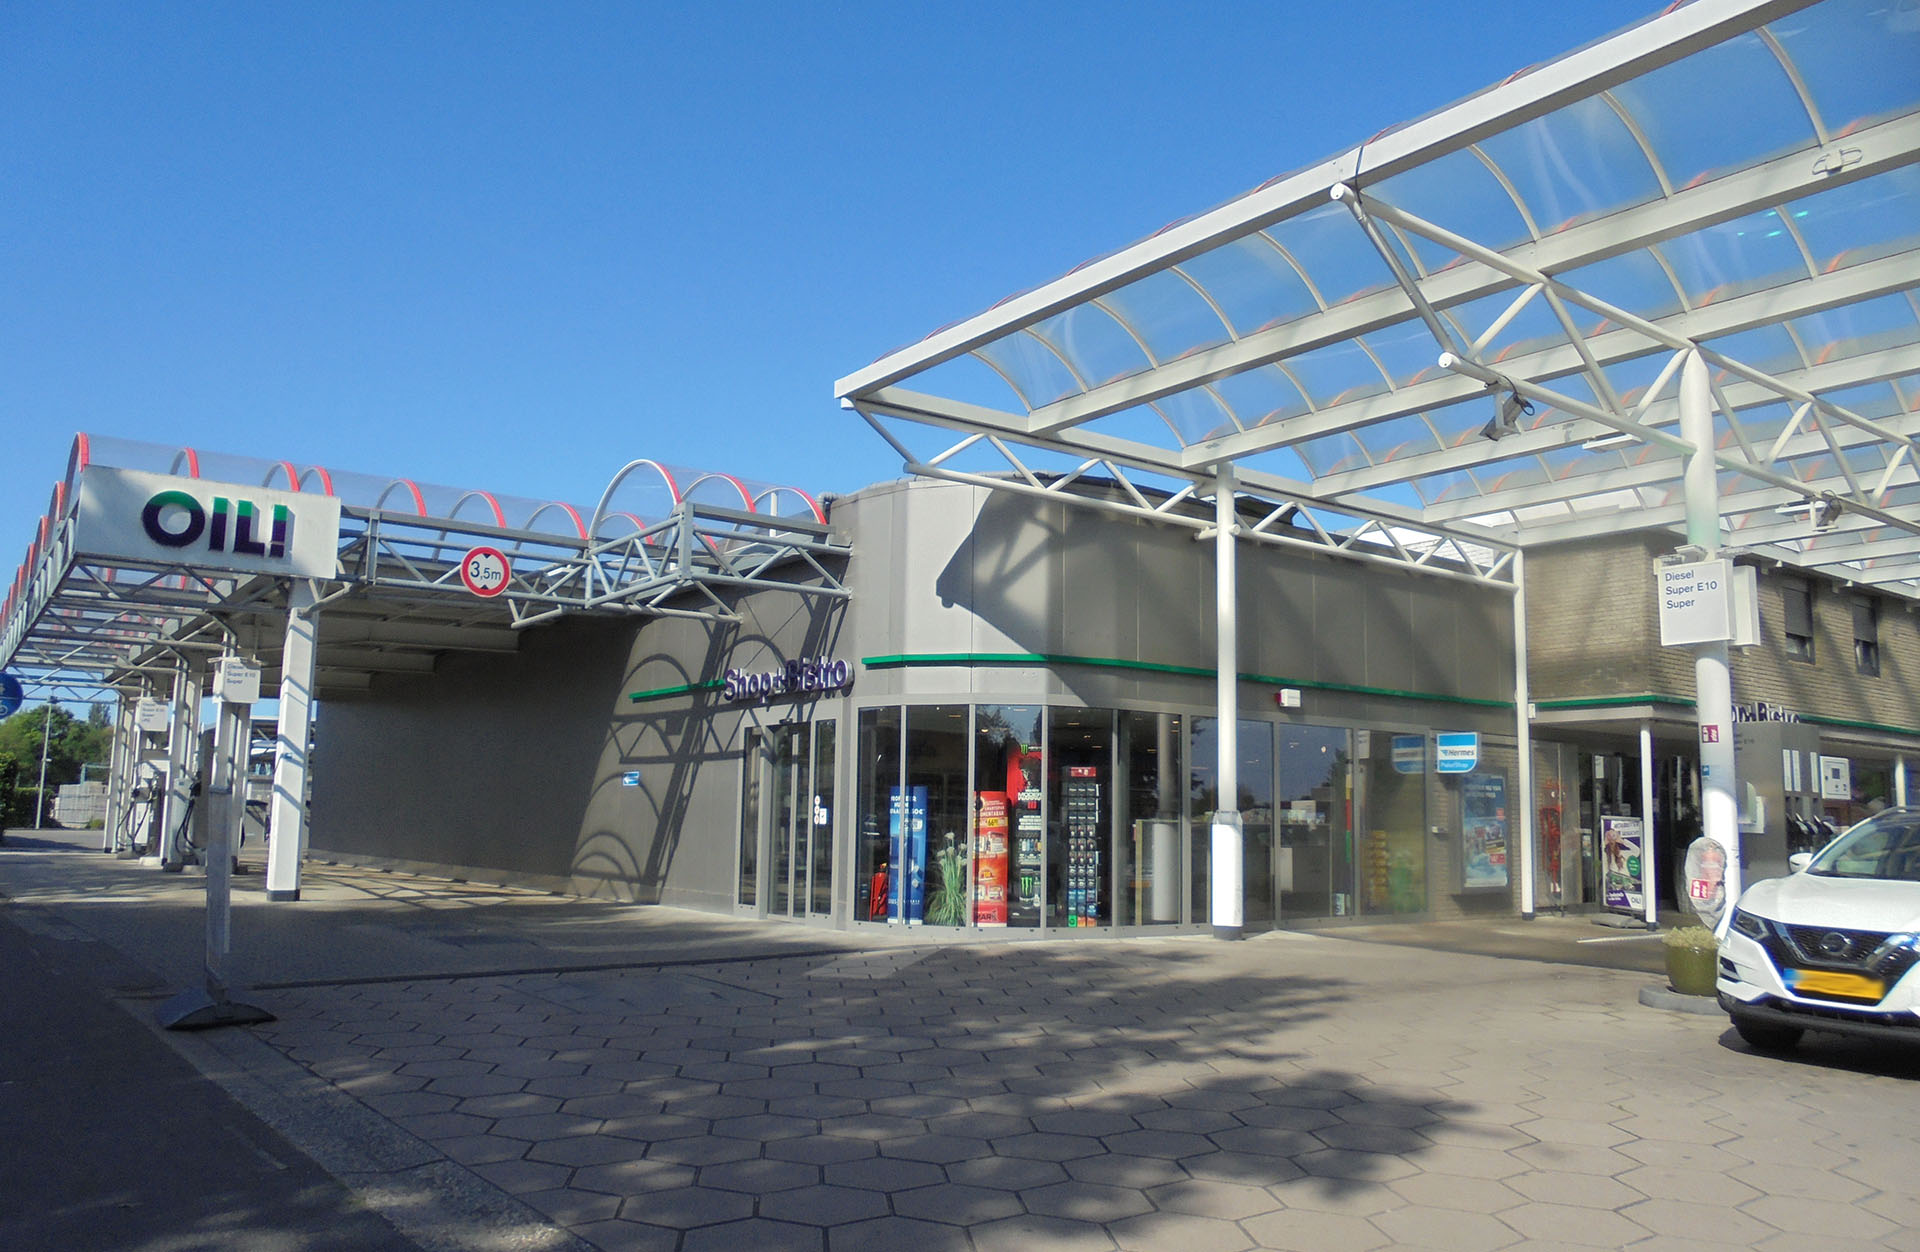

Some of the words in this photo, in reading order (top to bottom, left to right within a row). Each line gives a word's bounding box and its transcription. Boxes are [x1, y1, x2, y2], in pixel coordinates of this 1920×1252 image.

[141, 489, 288, 558] OIL!
[470, 560, 502, 580] 3,5m
[1665, 569, 1695, 582] Diesel
[1665, 585, 1695, 596] Super
[1697, 580, 1718, 592] E10
[1666, 599, 1696, 610] Super
[1448, 748, 1475, 757] Hermes
